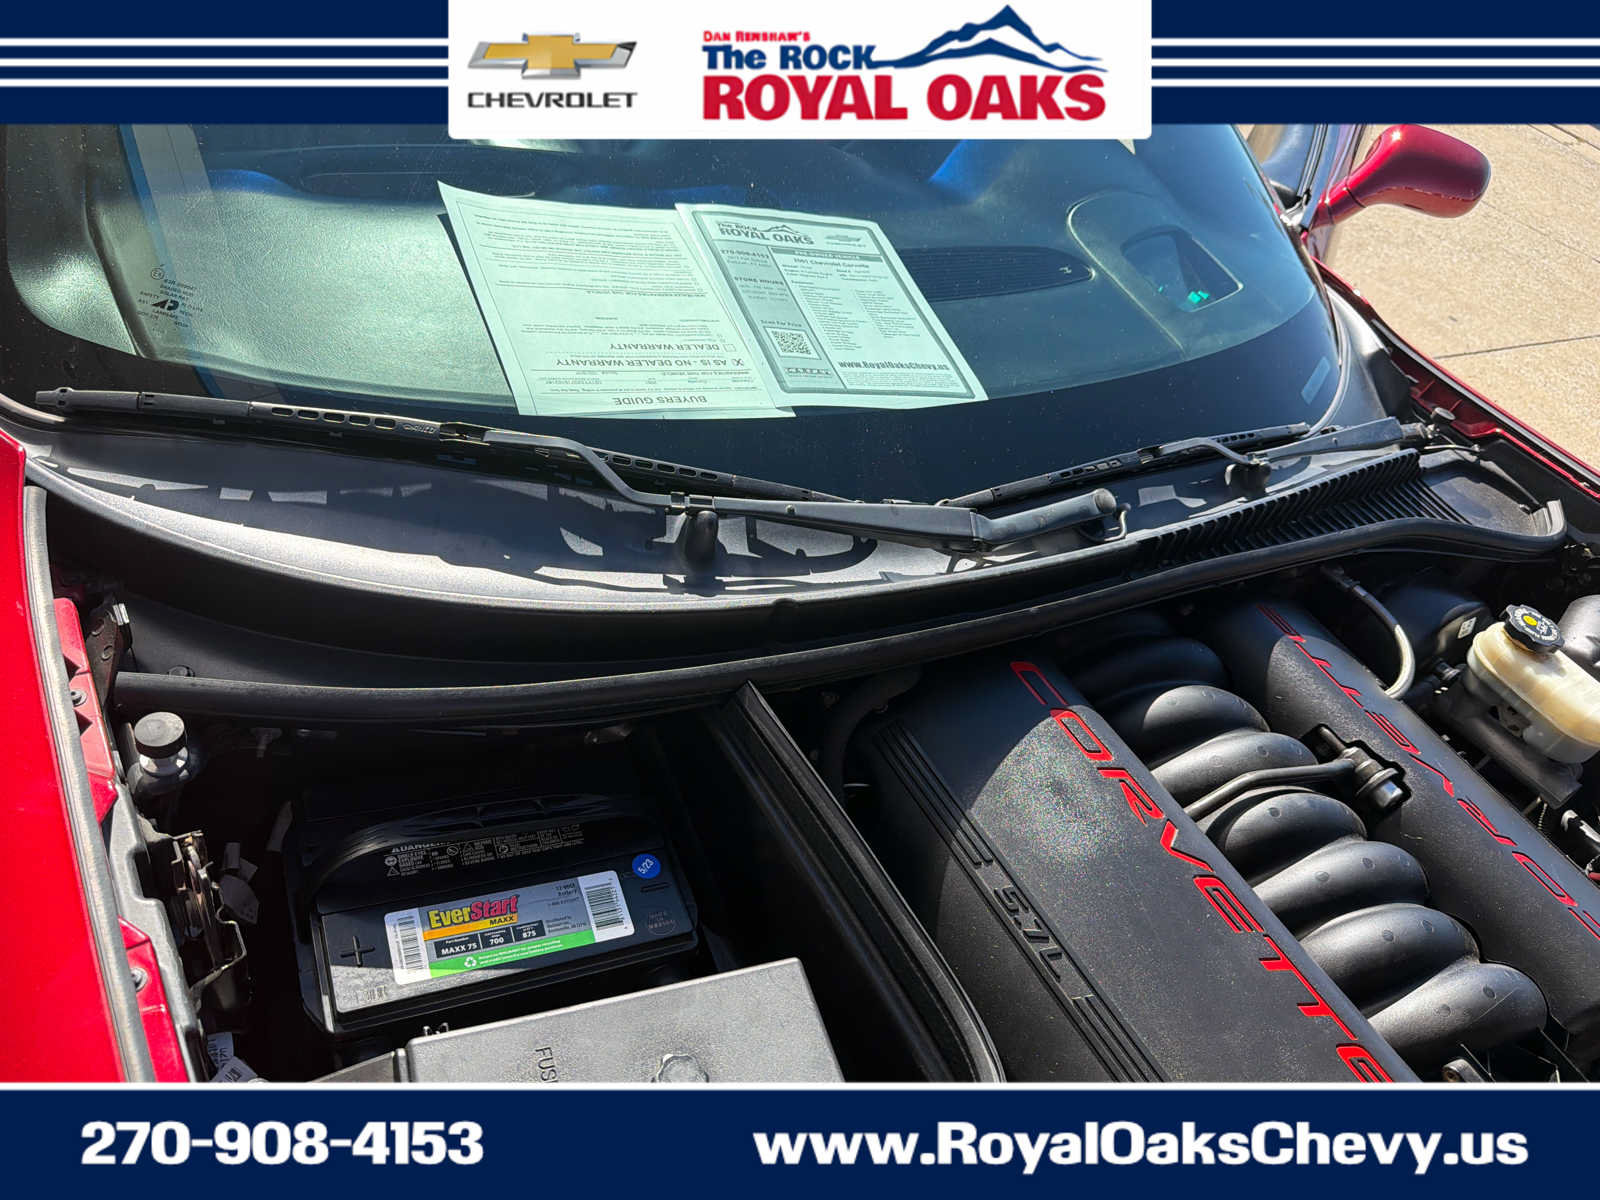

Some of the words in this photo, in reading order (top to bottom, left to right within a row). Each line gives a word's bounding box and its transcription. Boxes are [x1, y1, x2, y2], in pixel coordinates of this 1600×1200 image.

[720, 228, 770, 241] ROYAL
[772, 233, 815, 245] OAKS
[610, 342, 675, 351] WARRANTY
[677, 343, 720, 351] DEALER
[556, 358, 624, 368] WARRANTY
[626, 359, 672, 368] DEALER
[675, 359, 692, 367] NO
[700, 359, 712, 367] IS
[713, 359, 727, 367] AS
[614, 396, 654, 406] GUIDE
[655, 394, 708, 404] BUYERS
[1010, 660, 1395, 1083] CORVETTE
[427, 894, 519, 930] EverStart
[489, 914, 515, 926] MAXX
[521, 929, 537, 939] 875
[489, 936, 505, 946] 700
[441, 945, 466, 957] MAXX
[467, 942, 478, 950] 75
[534, 1045, 559, 1082] FUS
